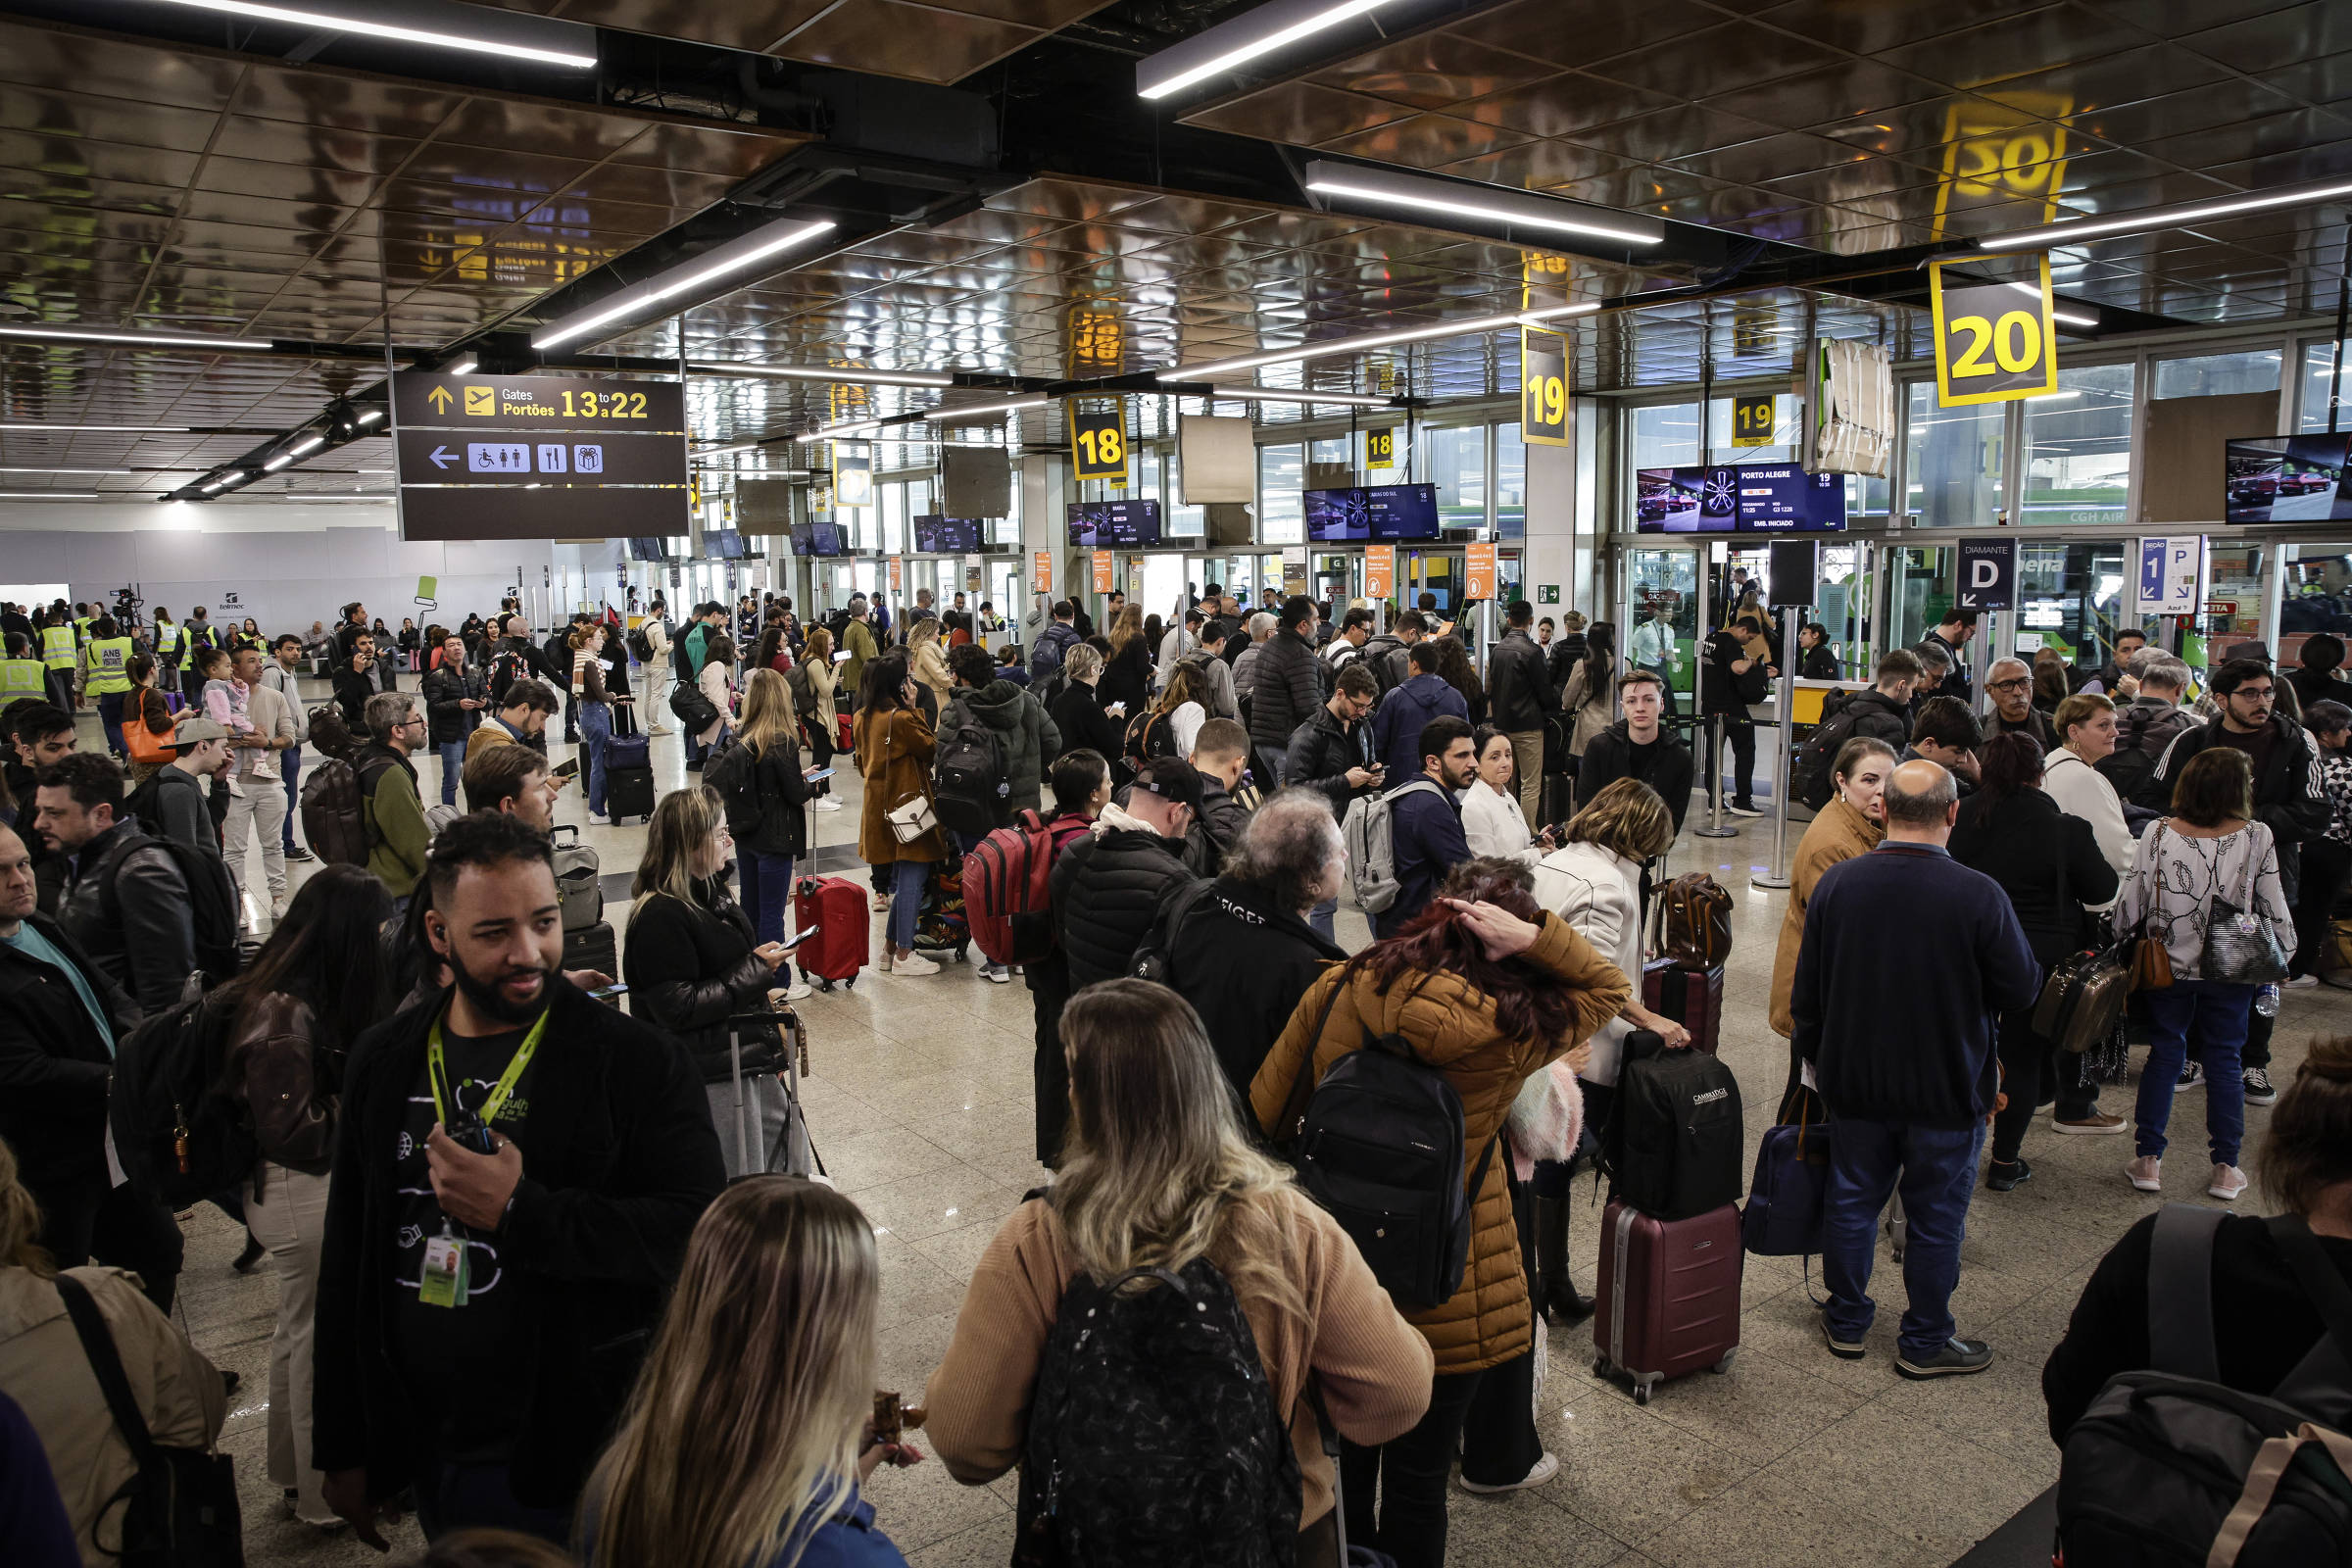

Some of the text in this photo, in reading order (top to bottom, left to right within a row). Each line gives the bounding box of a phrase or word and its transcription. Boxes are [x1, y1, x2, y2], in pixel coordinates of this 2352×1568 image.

[1949, 310, 2041, 379] 20
[502, 389, 533, 401] Gates
[562, 391, 610, 417] 13 to
[601, 392, 648, 418] a 22
[1528, 374, 1565, 425] 19
[503, 403, 556, 416] Portões
[1739, 404, 1771, 429] 19
[1078, 428, 1121, 465] 18
[1370, 435, 1391, 455] 18
[839, 468, 868, 497] 17
[1819, 473, 1831, 482] 19
[2070, 512, 2127, 522] CGH AIR
[1965, 546, 2008, 555] DIAMANTE
[2175, 550, 2187, 564] P
[1972, 560, 1999, 588] D
[2147, 557, 2158, 578] 1
[103, 649, 121, 658] ANB
[1692, 1087, 1726, 1102] CAMBRIDGE
